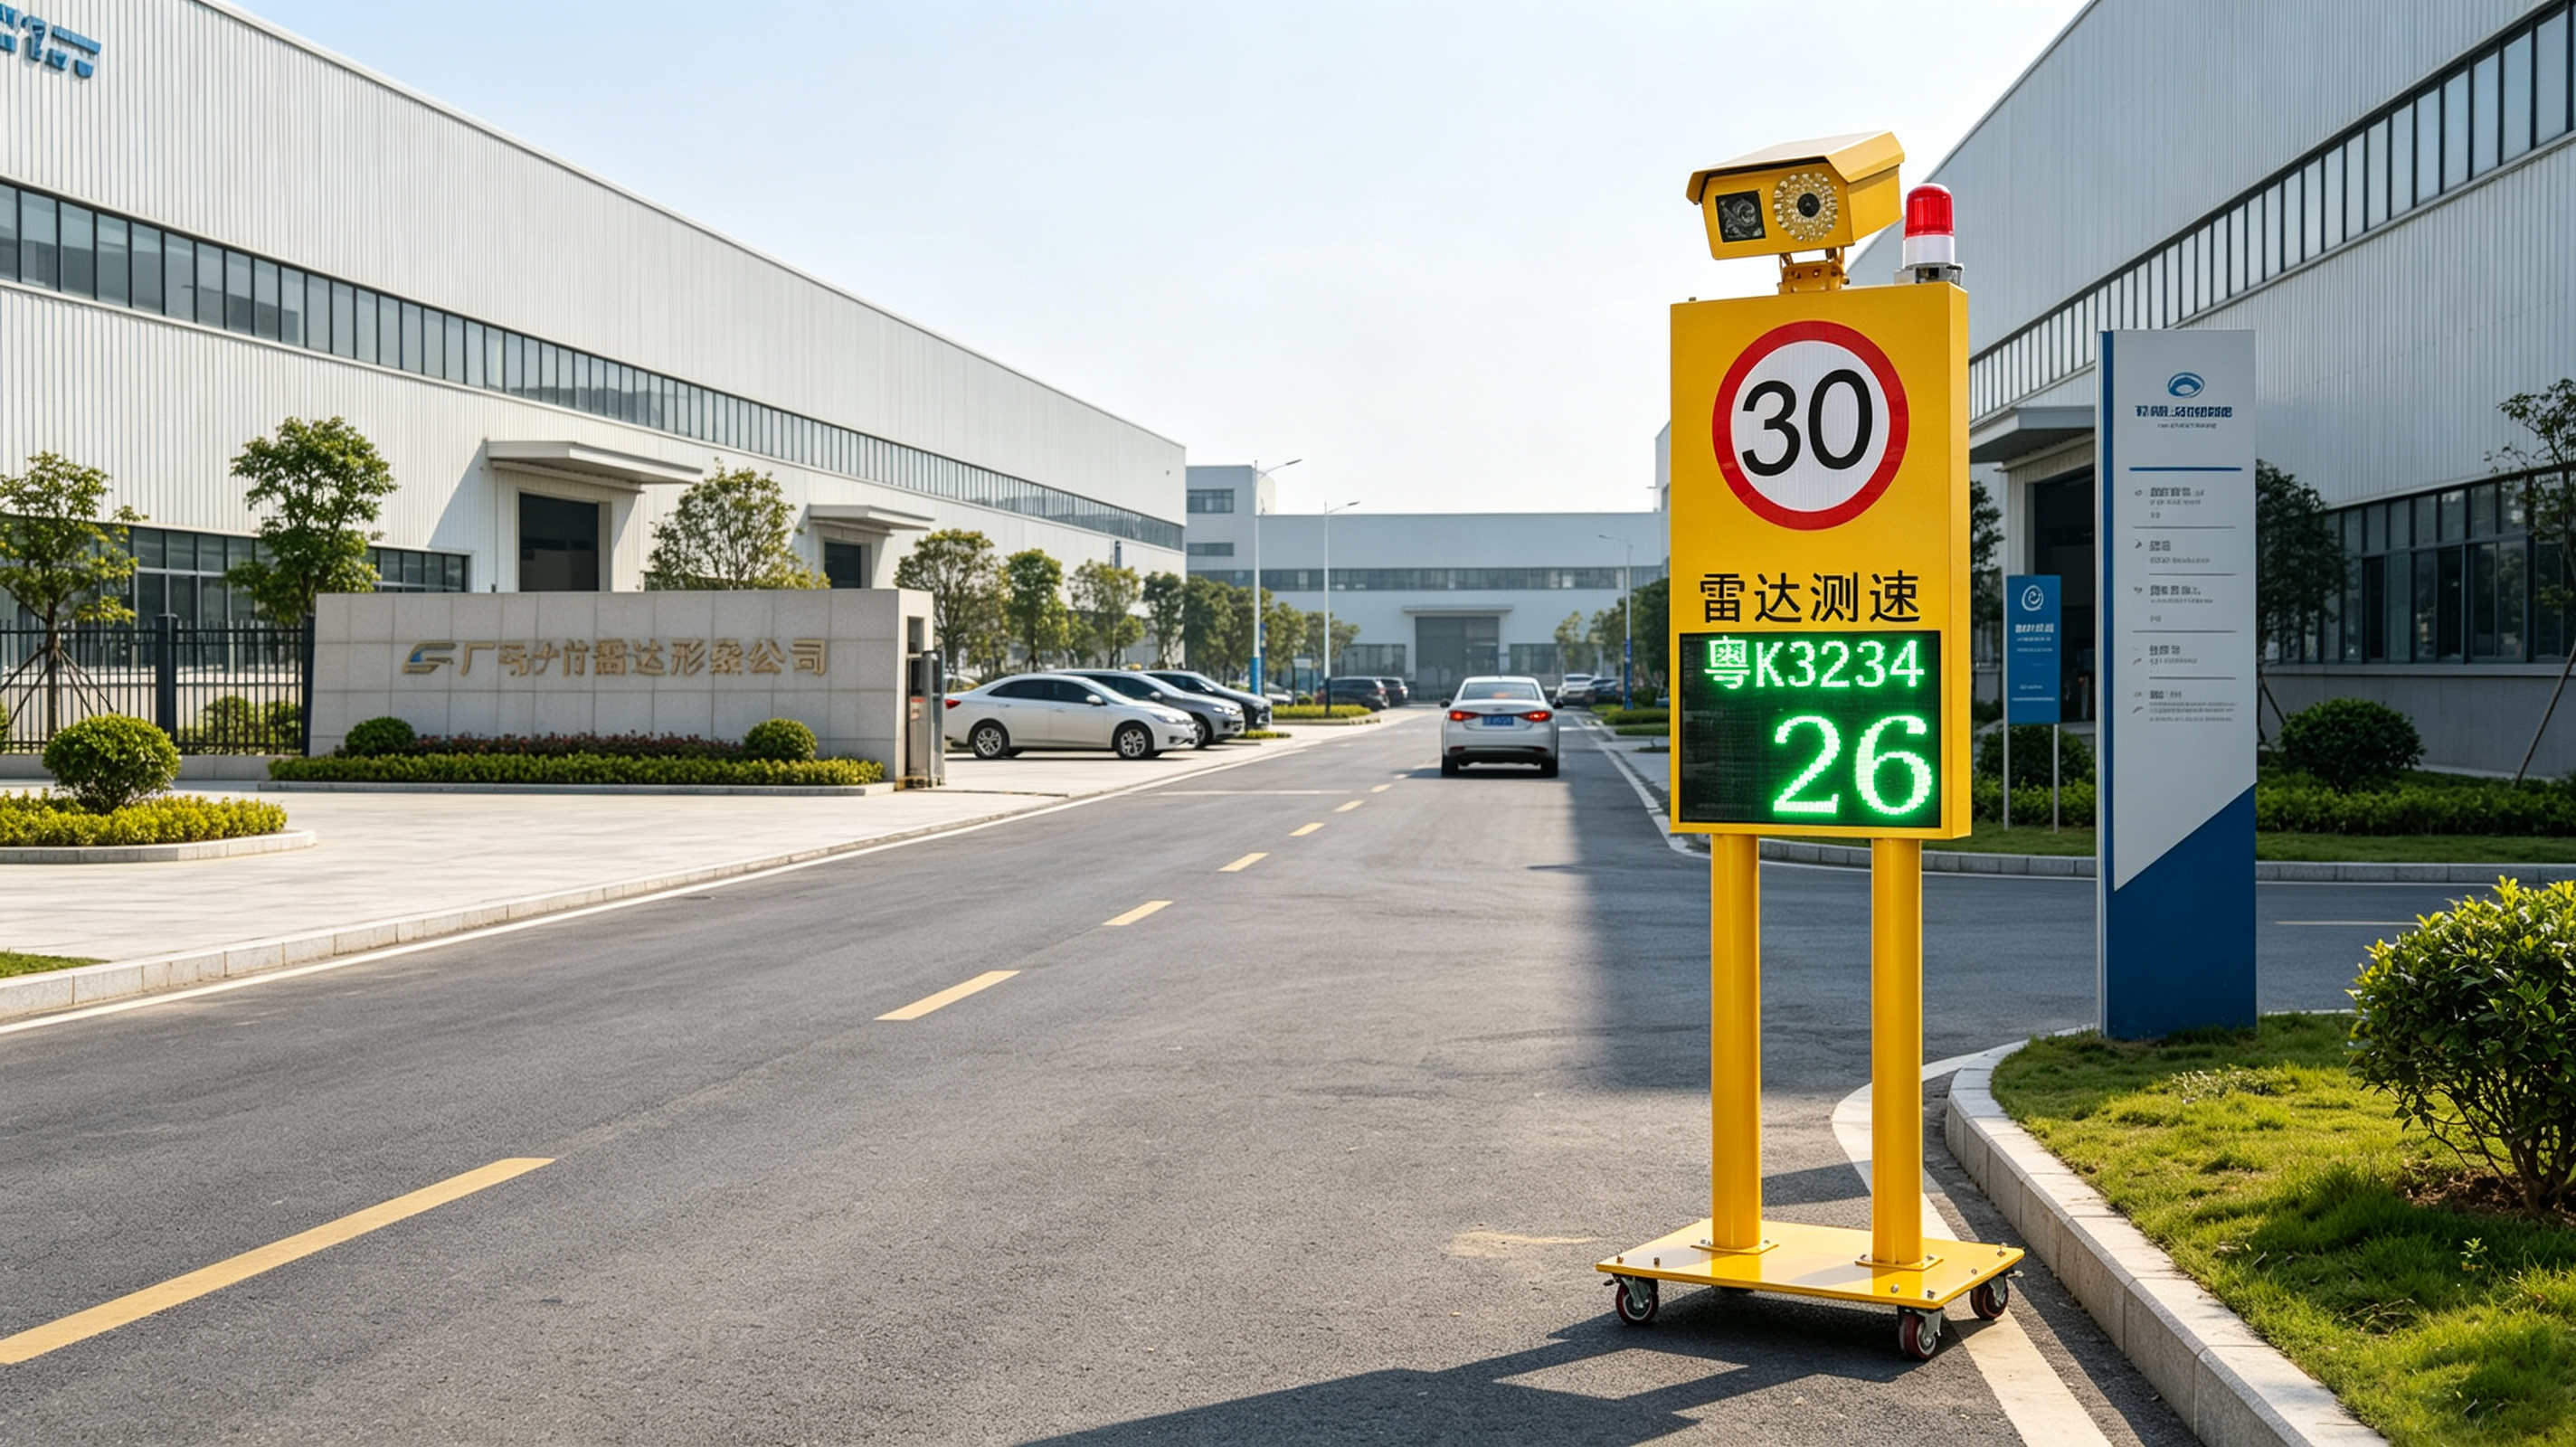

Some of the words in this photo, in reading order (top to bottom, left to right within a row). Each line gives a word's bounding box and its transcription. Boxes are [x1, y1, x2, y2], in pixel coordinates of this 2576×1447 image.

[1741, 369, 1873, 477] 30
[1700, 570, 1921, 623] 雷达测速
[1704, 635, 1925, 690] 粤K3234
[1773, 715, 1934, 816] 26
